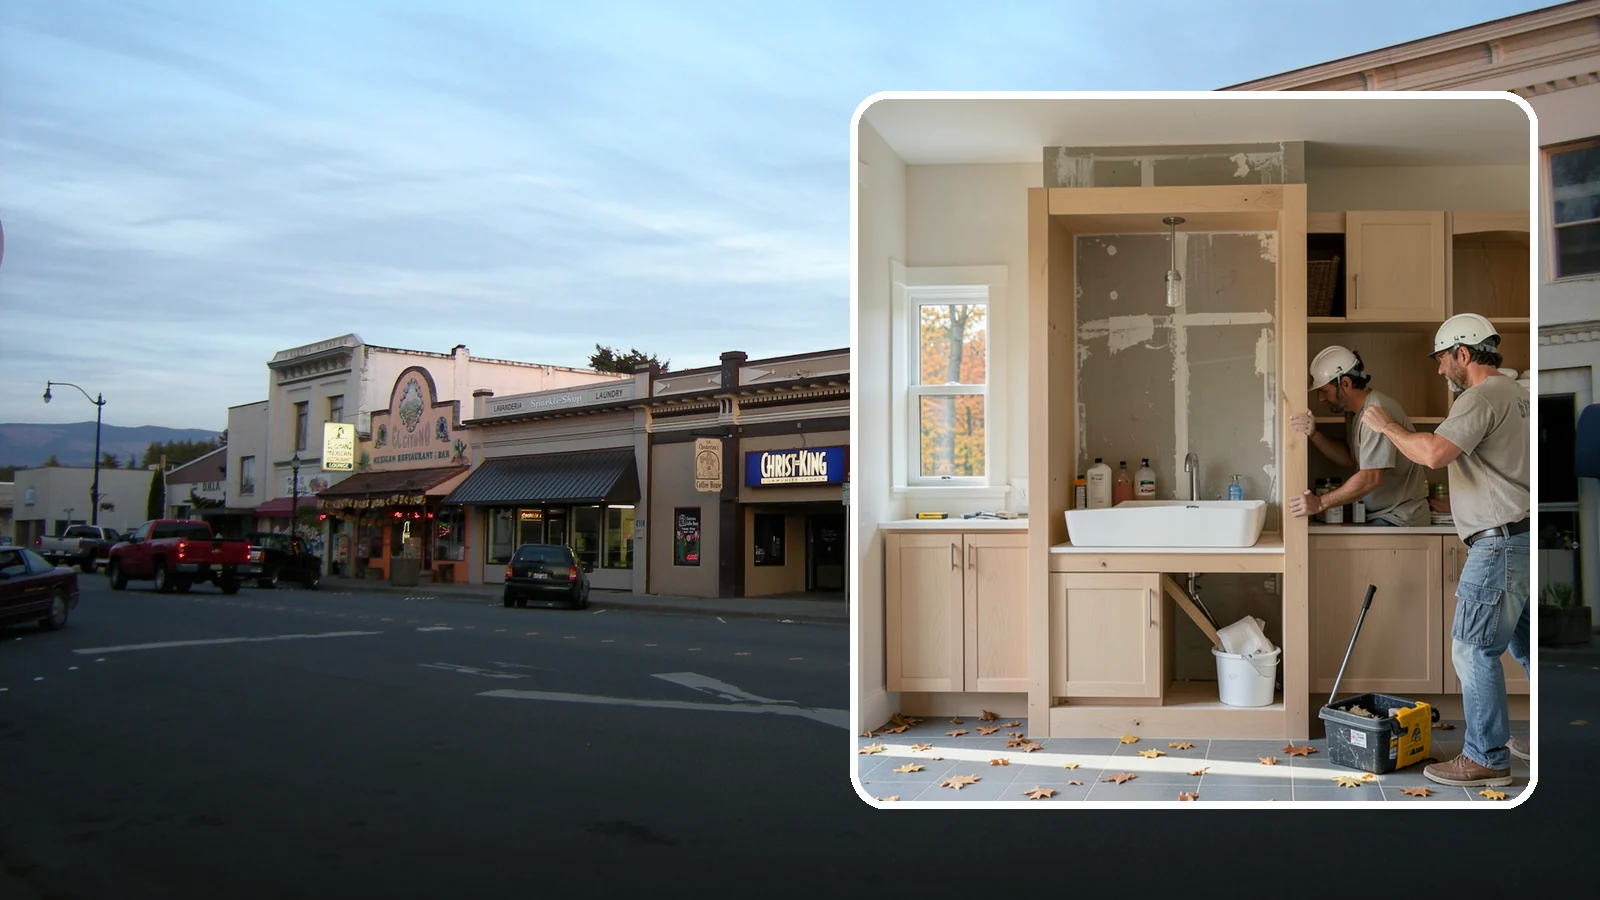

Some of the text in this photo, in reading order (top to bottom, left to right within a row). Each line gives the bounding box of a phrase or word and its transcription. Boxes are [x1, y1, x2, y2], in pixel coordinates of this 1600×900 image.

[561, 394, 583, 405] Shop
[595, 389, 624, 400] LAUNDRY
[494, 402, 523, 413] LAVANDERIA
[374, 451, 450, 464] MEXICAN RESTAURANT BAR
[761, 450, 828, 478] CHRIST KING
[696, 480, 709, 489] Coffee
